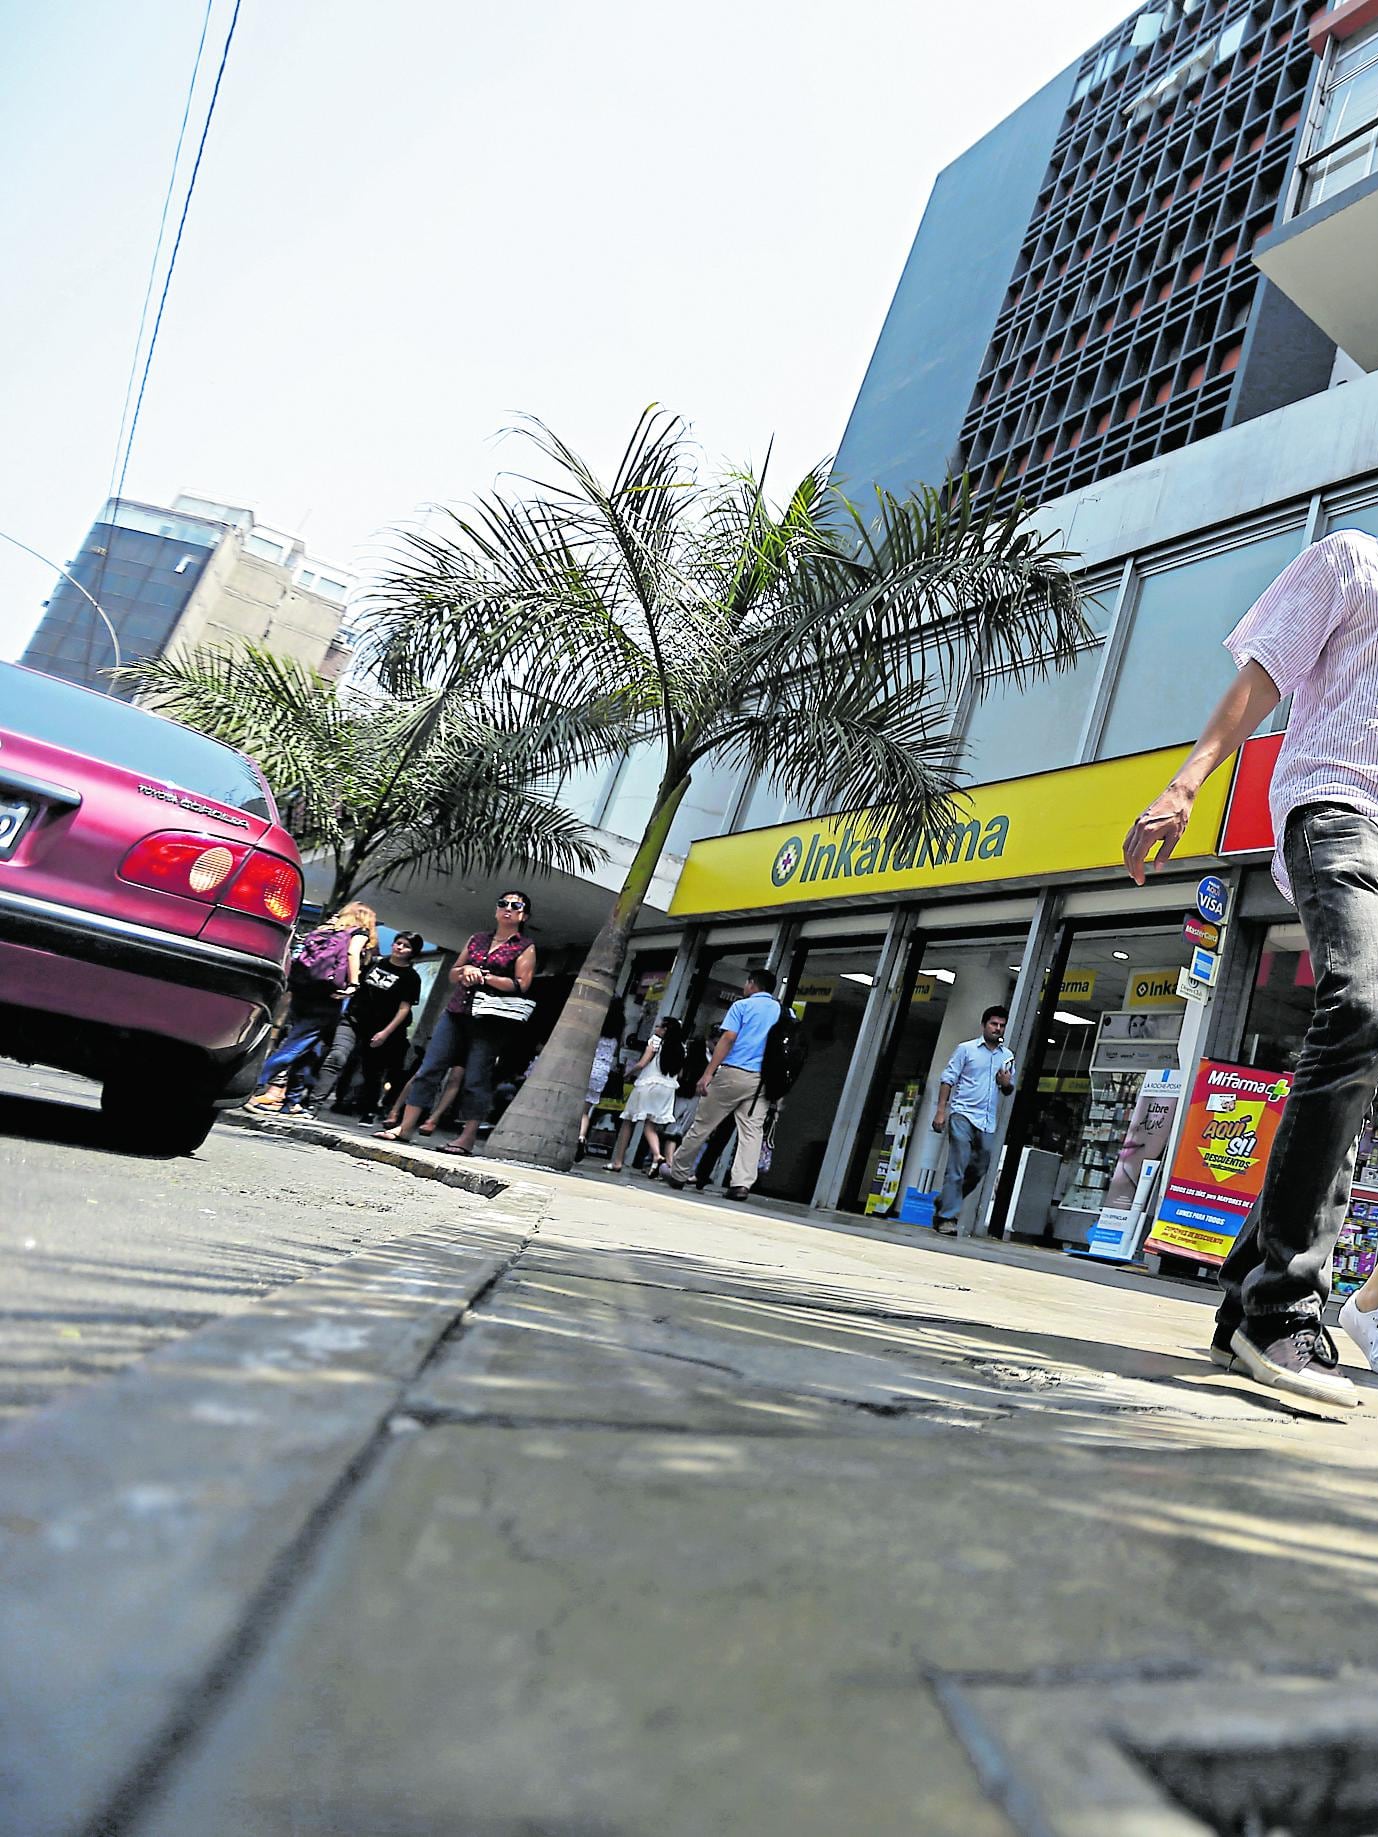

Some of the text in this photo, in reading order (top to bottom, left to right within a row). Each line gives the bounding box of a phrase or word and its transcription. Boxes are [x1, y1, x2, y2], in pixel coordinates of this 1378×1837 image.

[1199, 892, 1223, 915] VISA
[1185, 925, 1218, 942] MasterCard
[1207, 1070, 1266, 1094] Mifarma
[1147, 1103, 1170, 1114] Libre
[1202, 1115, 1252, 1140] AQUÍ
[1204, 1152, 1251, 1170] DESCUENTOS
